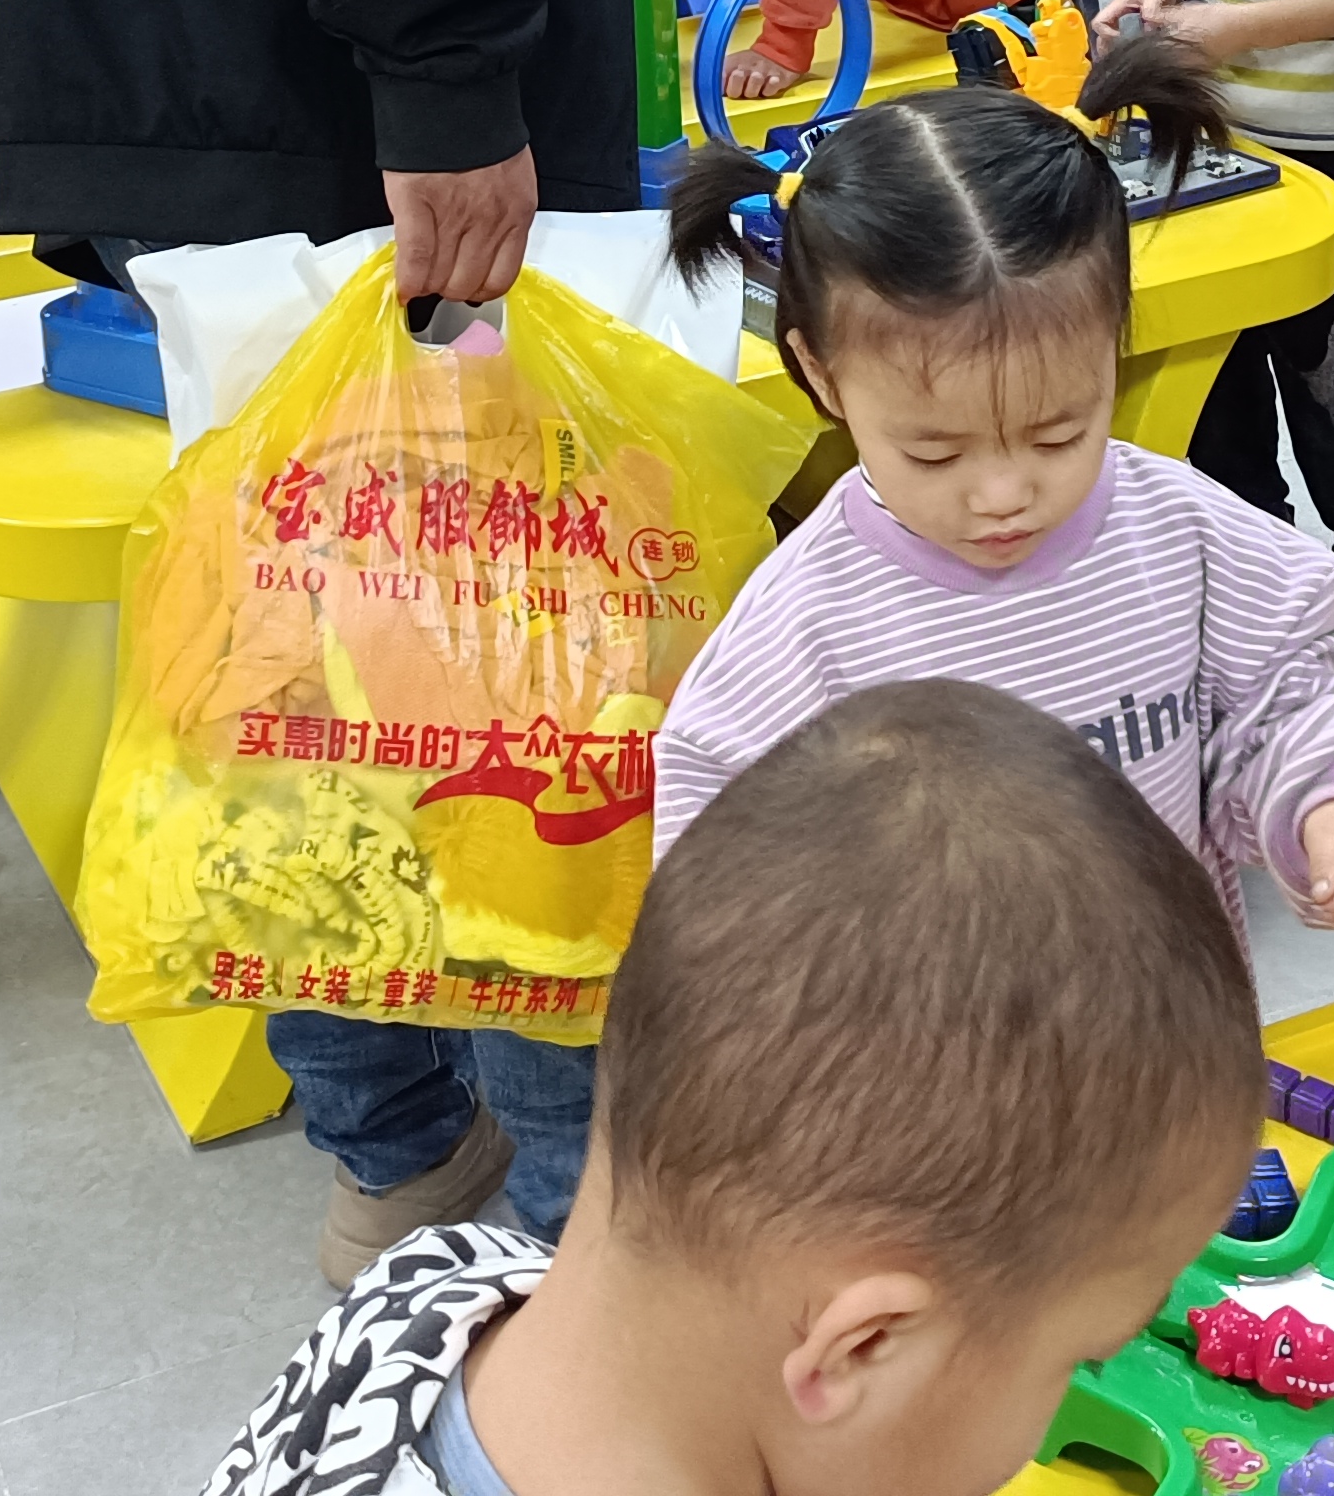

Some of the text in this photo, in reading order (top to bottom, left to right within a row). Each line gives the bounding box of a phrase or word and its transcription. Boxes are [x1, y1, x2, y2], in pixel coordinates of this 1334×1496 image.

[640, 538, 696, 564] 连锁
[255, 563, 707, 622] BAO WEI FU SHI CHENG
[210, 950, 583, 1015] 男装 女装 童装 牛仔系列
